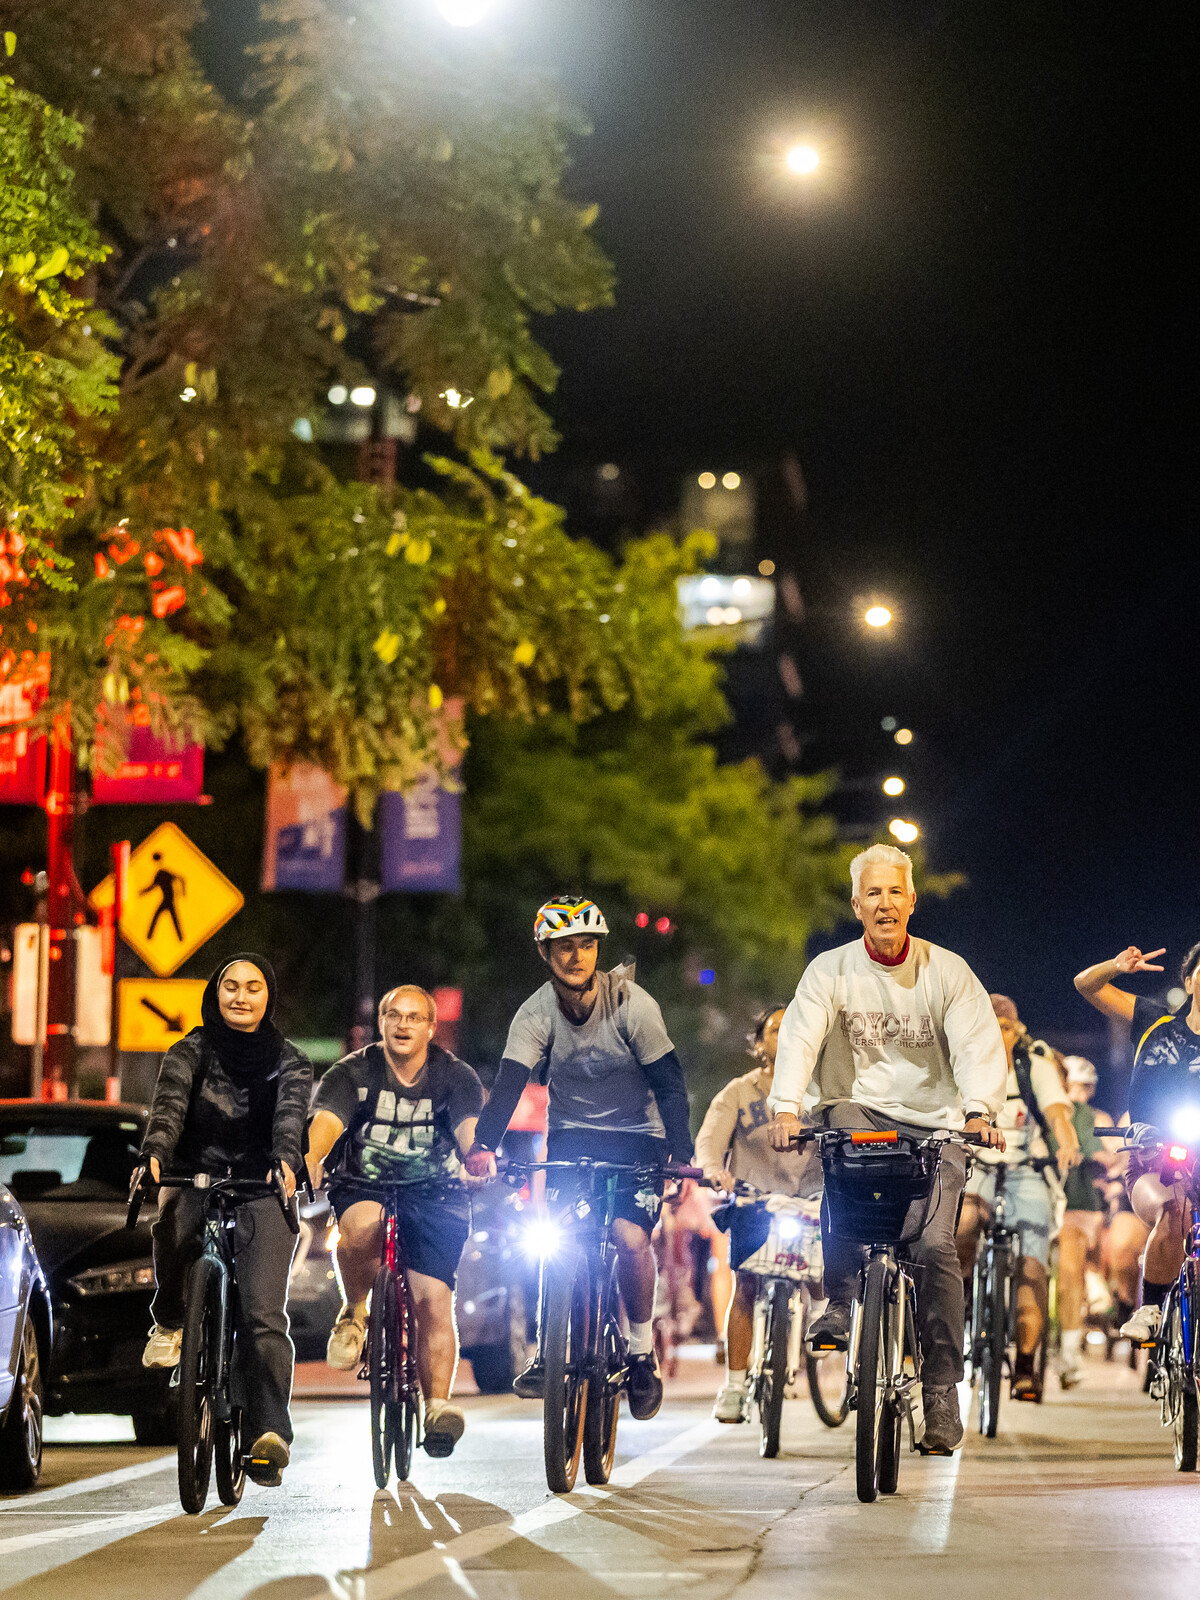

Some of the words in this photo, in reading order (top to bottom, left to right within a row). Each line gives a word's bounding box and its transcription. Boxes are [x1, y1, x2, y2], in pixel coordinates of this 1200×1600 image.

[838, 1010, 935, 1041] LOYOLA
[855, 1038, 888, 1047] ERSITY
[894, 1038, 934, 1049] CHICAGO
